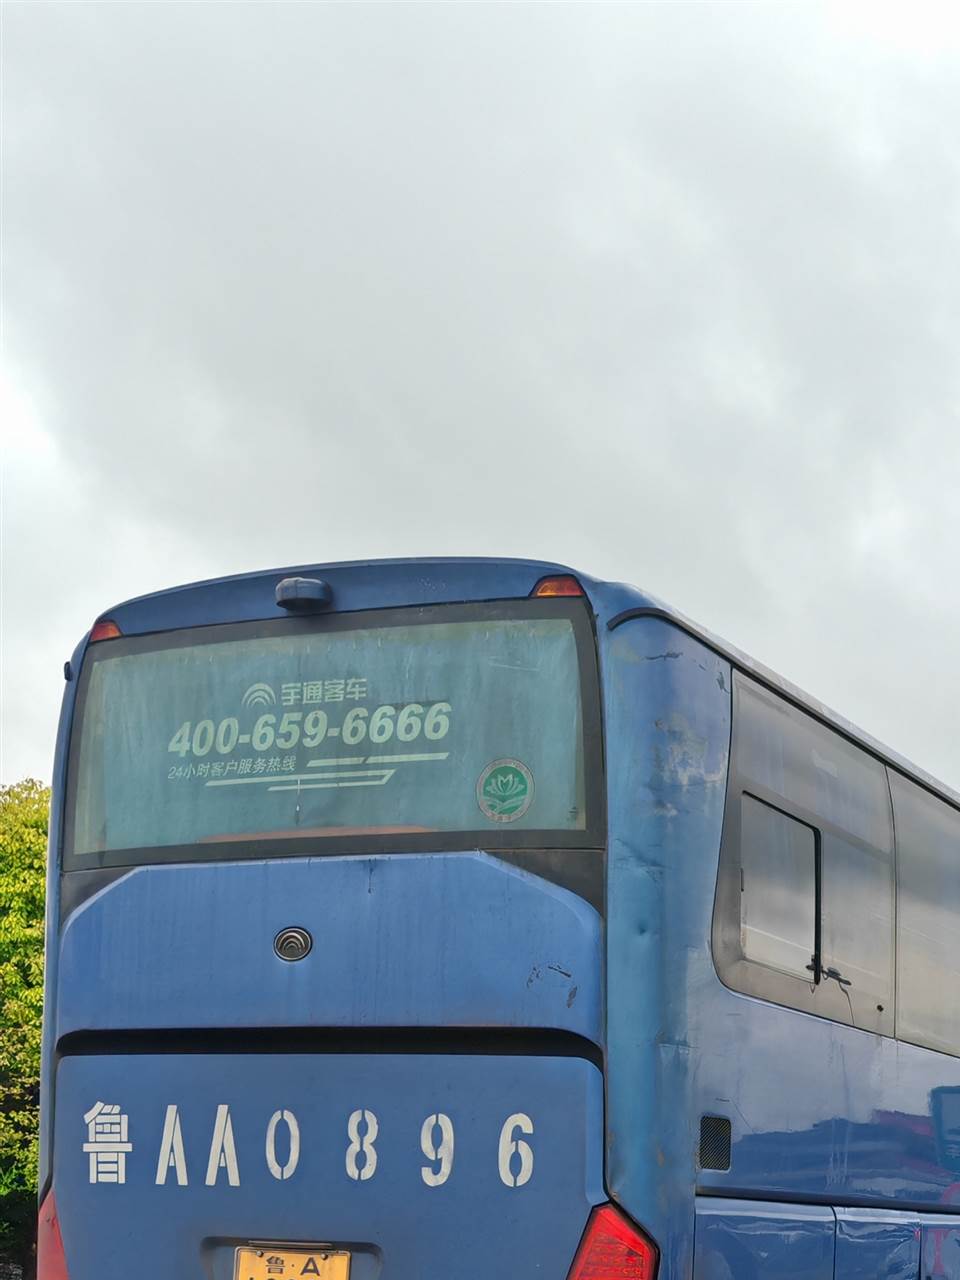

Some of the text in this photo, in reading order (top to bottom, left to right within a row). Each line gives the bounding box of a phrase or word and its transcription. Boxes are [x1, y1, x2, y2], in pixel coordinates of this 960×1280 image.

[281, 678, 368, 706] 宇通客车
[168, 702, 452, 757] 400-659-6666
[167, 755, 297, 780] 24小时客户服务热线
